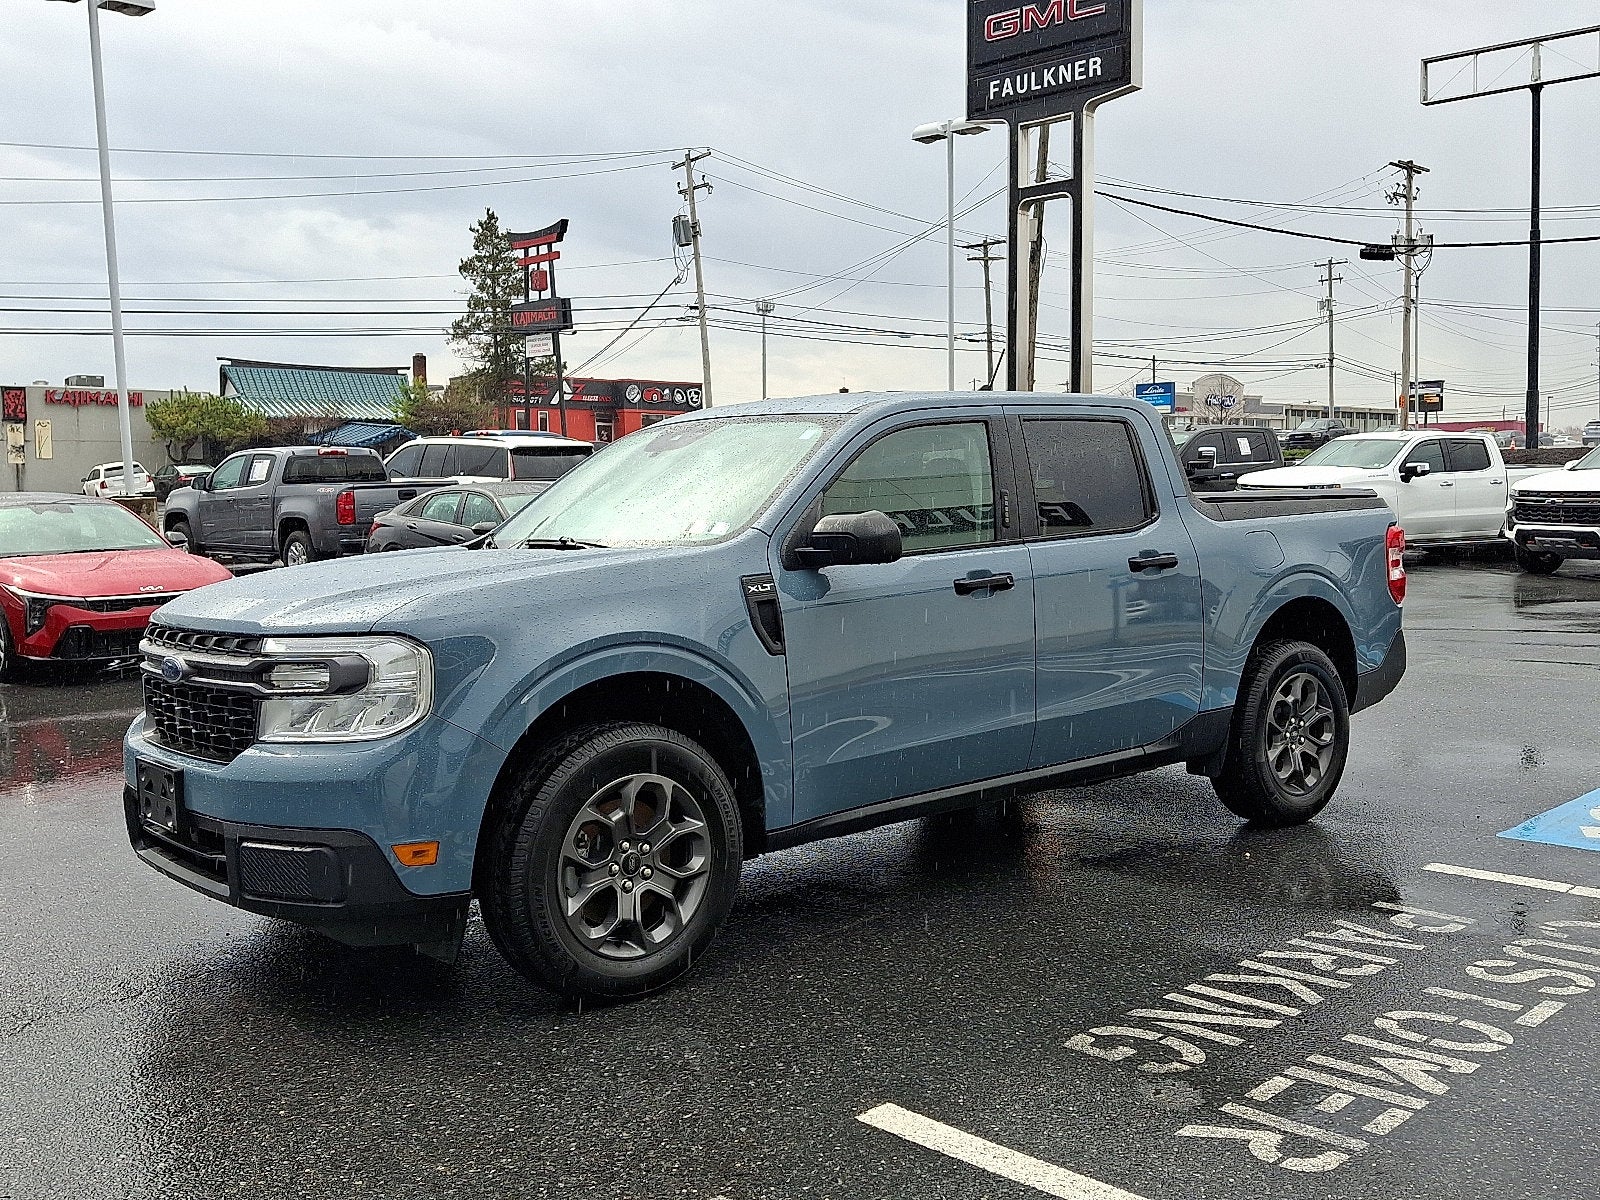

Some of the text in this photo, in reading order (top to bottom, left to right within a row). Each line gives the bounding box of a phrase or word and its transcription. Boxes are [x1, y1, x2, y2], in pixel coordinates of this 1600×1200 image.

[989, 56, 1102, 100] FAULKNER
[512, 306, 557, 326] KAJIMACHI
[747, 583, 774, 593] XLT
[1063, 901, 1475, 1074] PARKING
